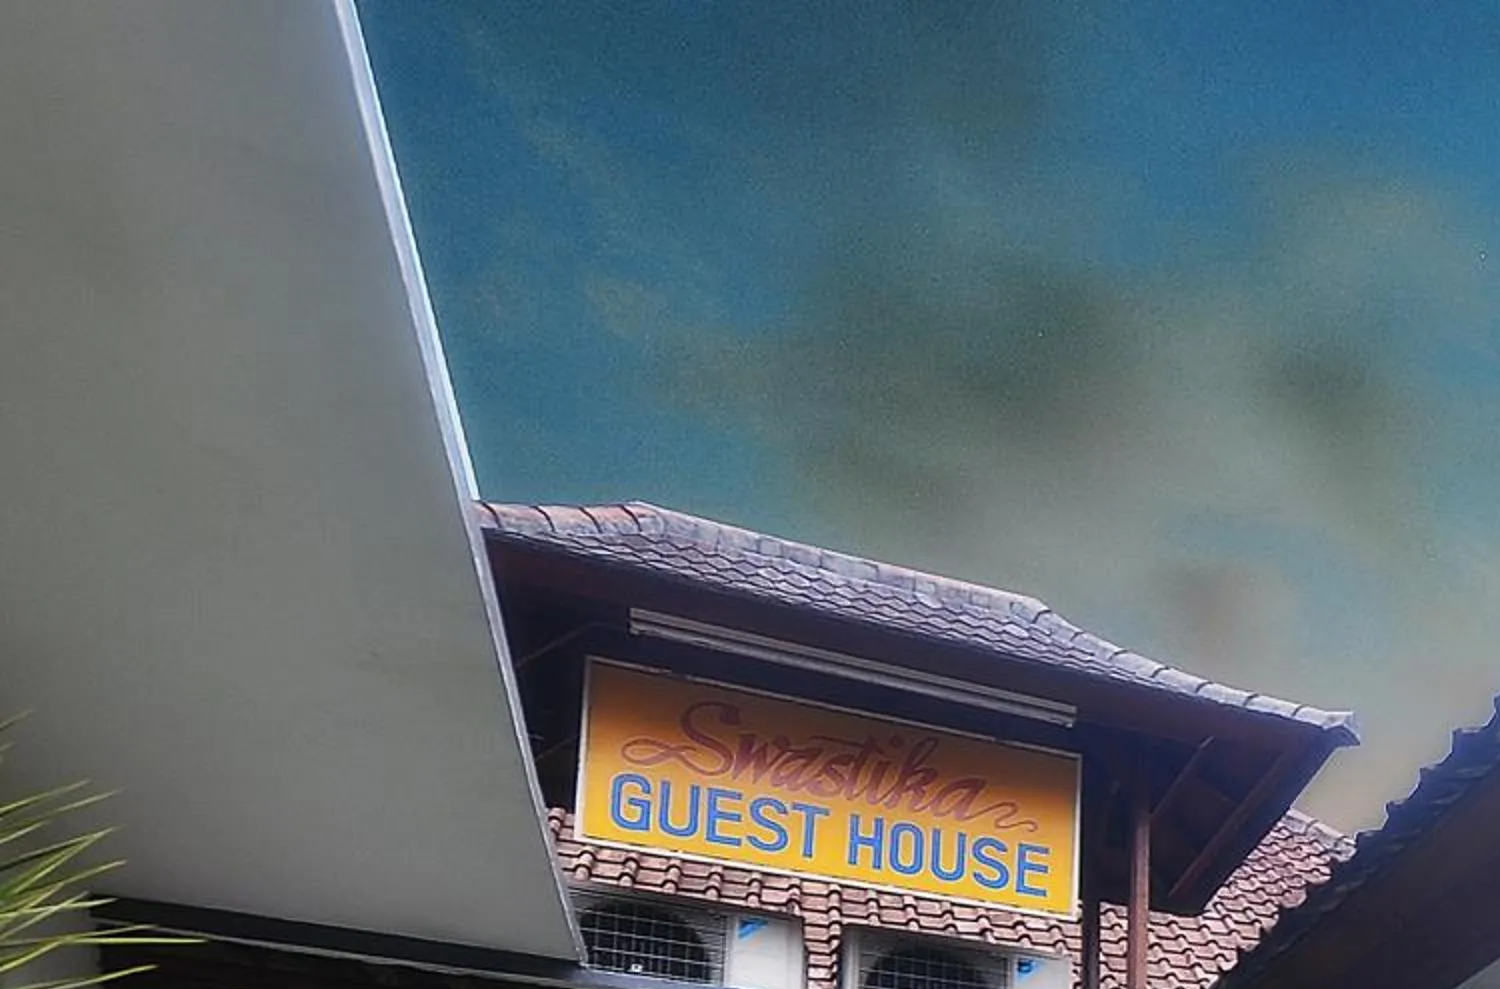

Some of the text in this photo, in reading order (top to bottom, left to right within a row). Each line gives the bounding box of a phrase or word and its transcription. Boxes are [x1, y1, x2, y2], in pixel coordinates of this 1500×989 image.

[621, 703, 1038, 832] Swastika
[610, 773, 1051, 897] GUEST HOUSE
